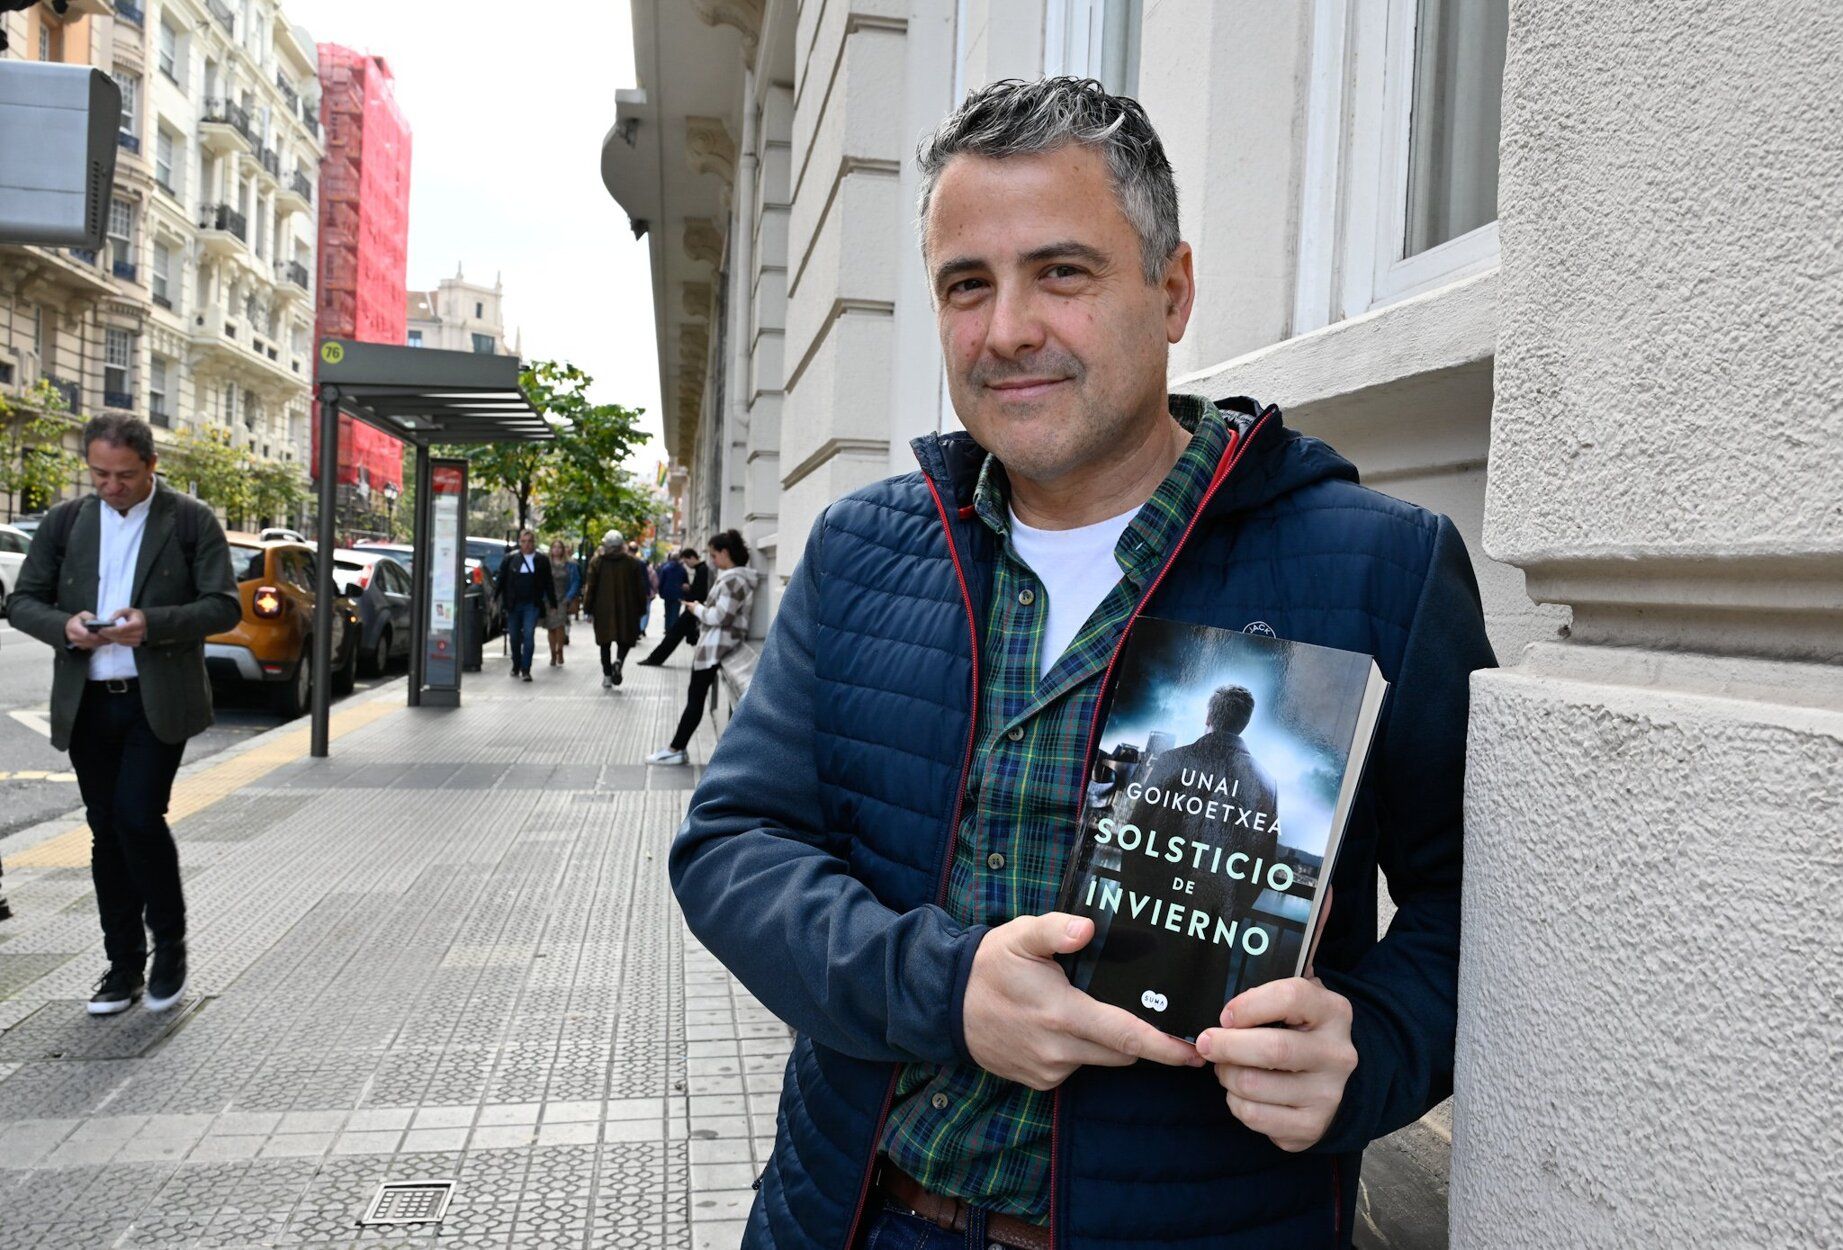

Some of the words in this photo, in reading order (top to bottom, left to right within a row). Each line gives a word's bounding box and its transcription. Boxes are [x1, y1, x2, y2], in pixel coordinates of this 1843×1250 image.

[325, 346, 340, 359] 76
[1248, 623, 1271, 635] JACK
[1180, 767, 1240, 799] UNAI
[1126, 782, 1284, 836] GOIKOETXEA
[1093, 817, 1295, 892] SOLSTICIO
[1172, 876, 1195, 896] DE
[1085, 879, 1270, 957] INVIERNO
[1144, 995, 1164, 1007] SUMA
